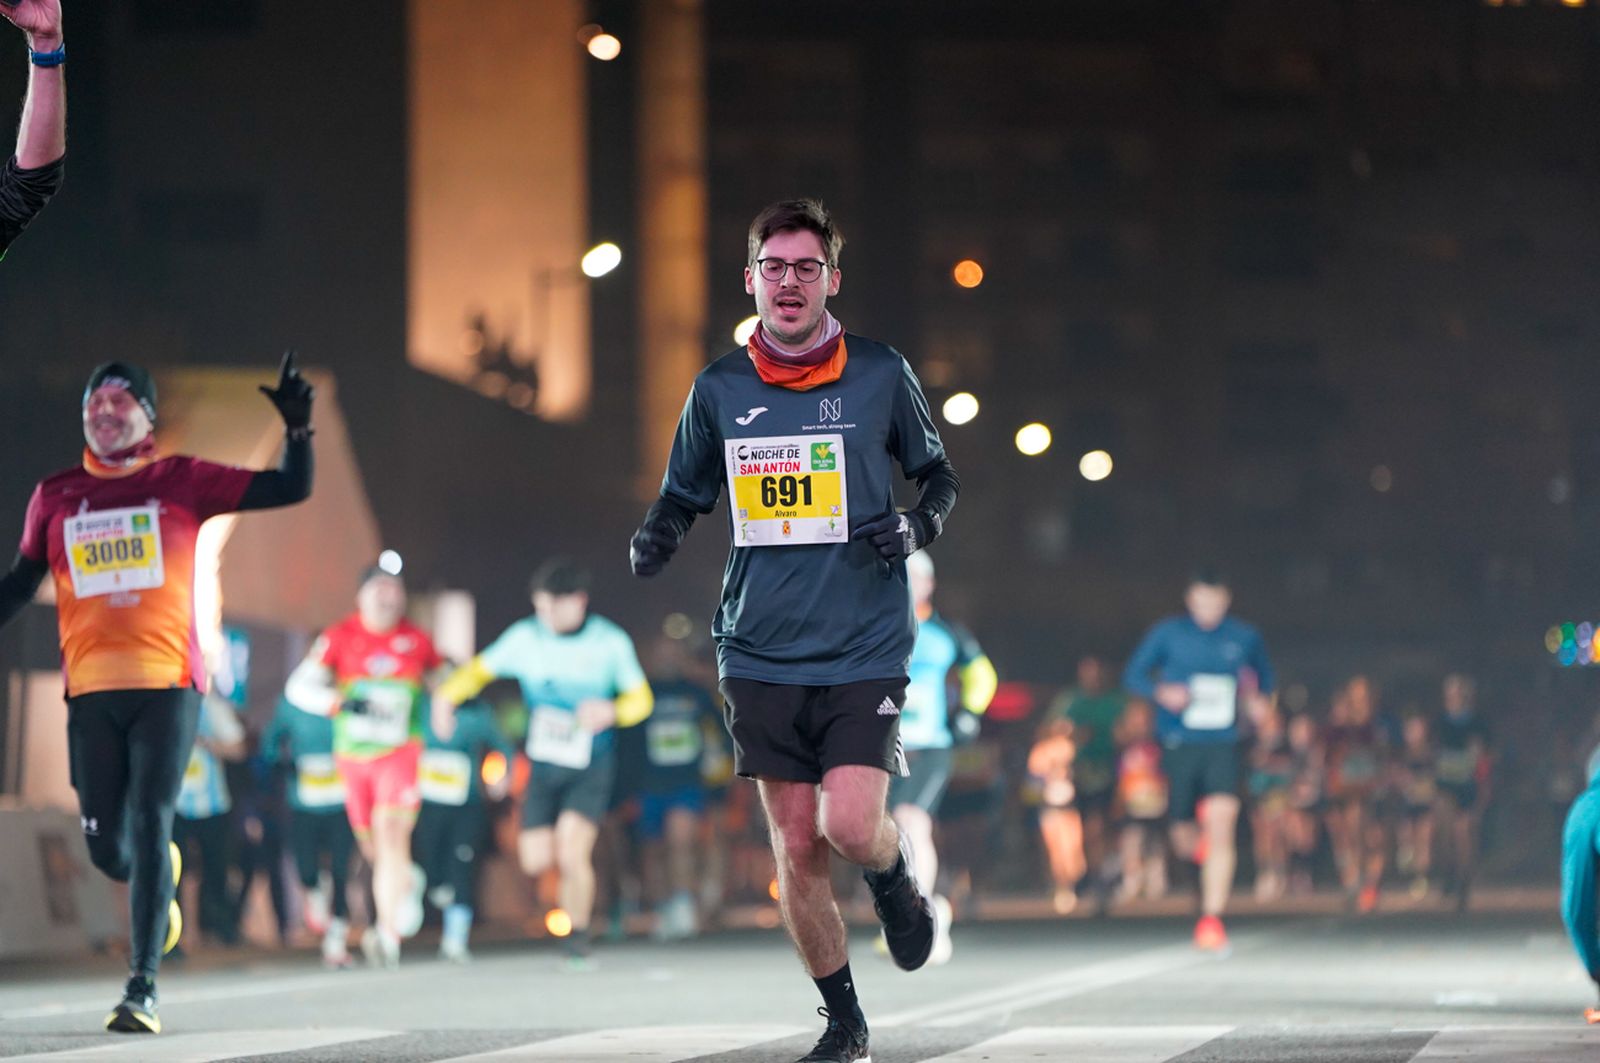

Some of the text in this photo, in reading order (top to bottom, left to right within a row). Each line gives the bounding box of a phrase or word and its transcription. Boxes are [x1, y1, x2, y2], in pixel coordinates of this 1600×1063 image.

[750, 448, 800, 461] NOCHE DE
[740, 463, 760, 475] SAN
[763, 459, 801, 474] ANTÓN
[761, 475, 813, 508] 691
[84, 537, 144, 568] 3008
